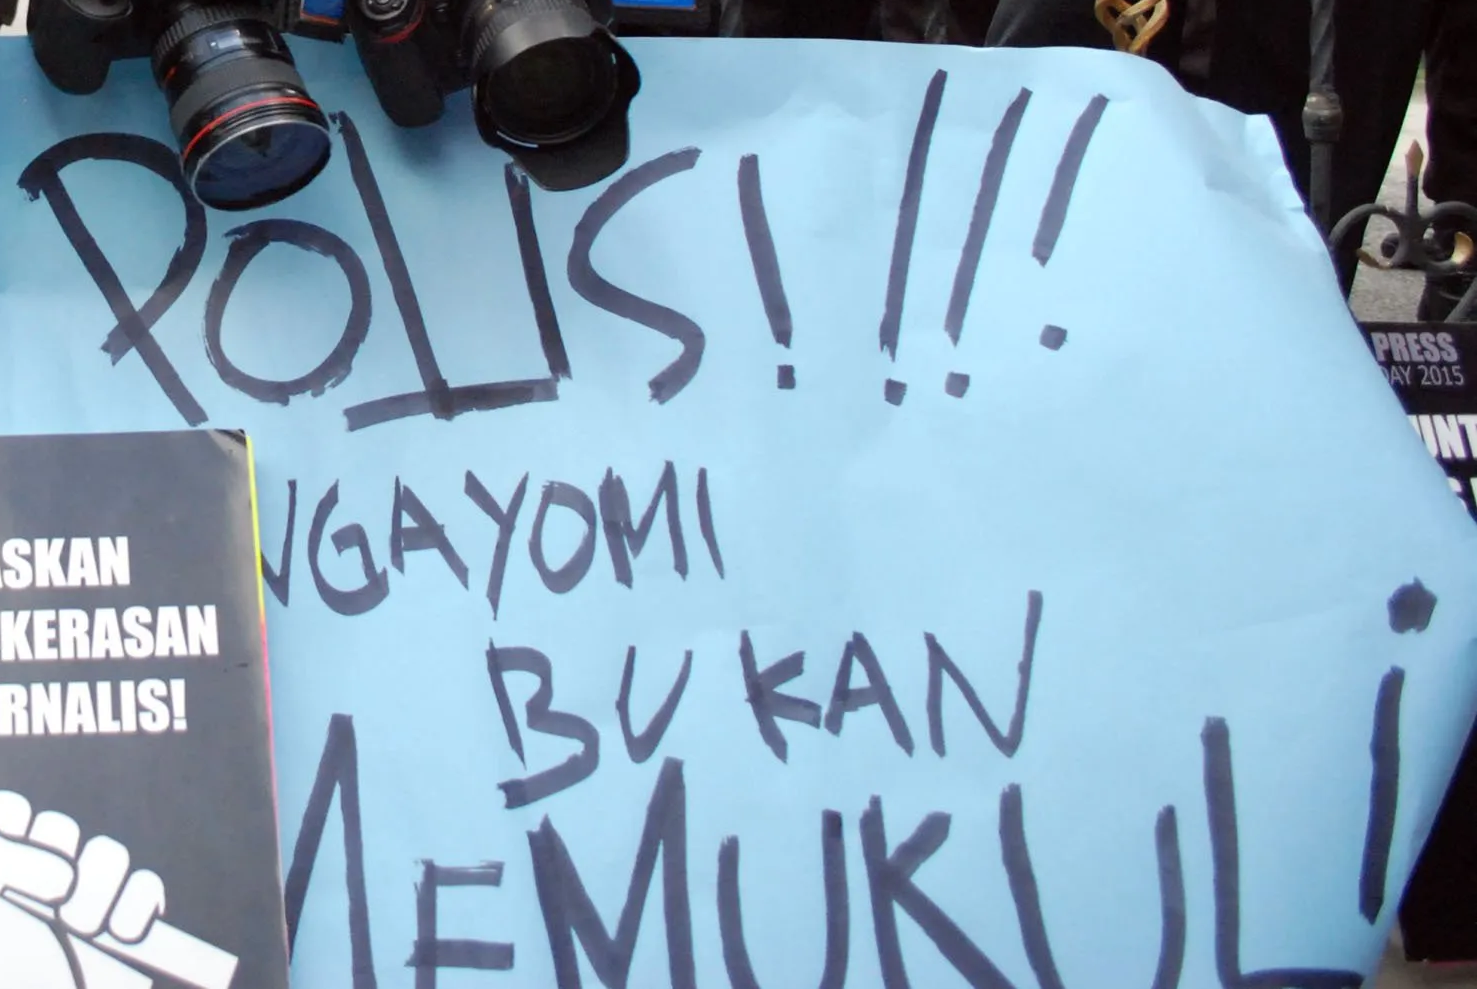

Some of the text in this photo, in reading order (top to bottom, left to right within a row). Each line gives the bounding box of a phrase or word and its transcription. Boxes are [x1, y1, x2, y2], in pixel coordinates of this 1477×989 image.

[1370, 331, 1459, 363] PRESS
[1420, 365, 1465, 385] 2015
[485, 589, 1042, 809] BUKAN
